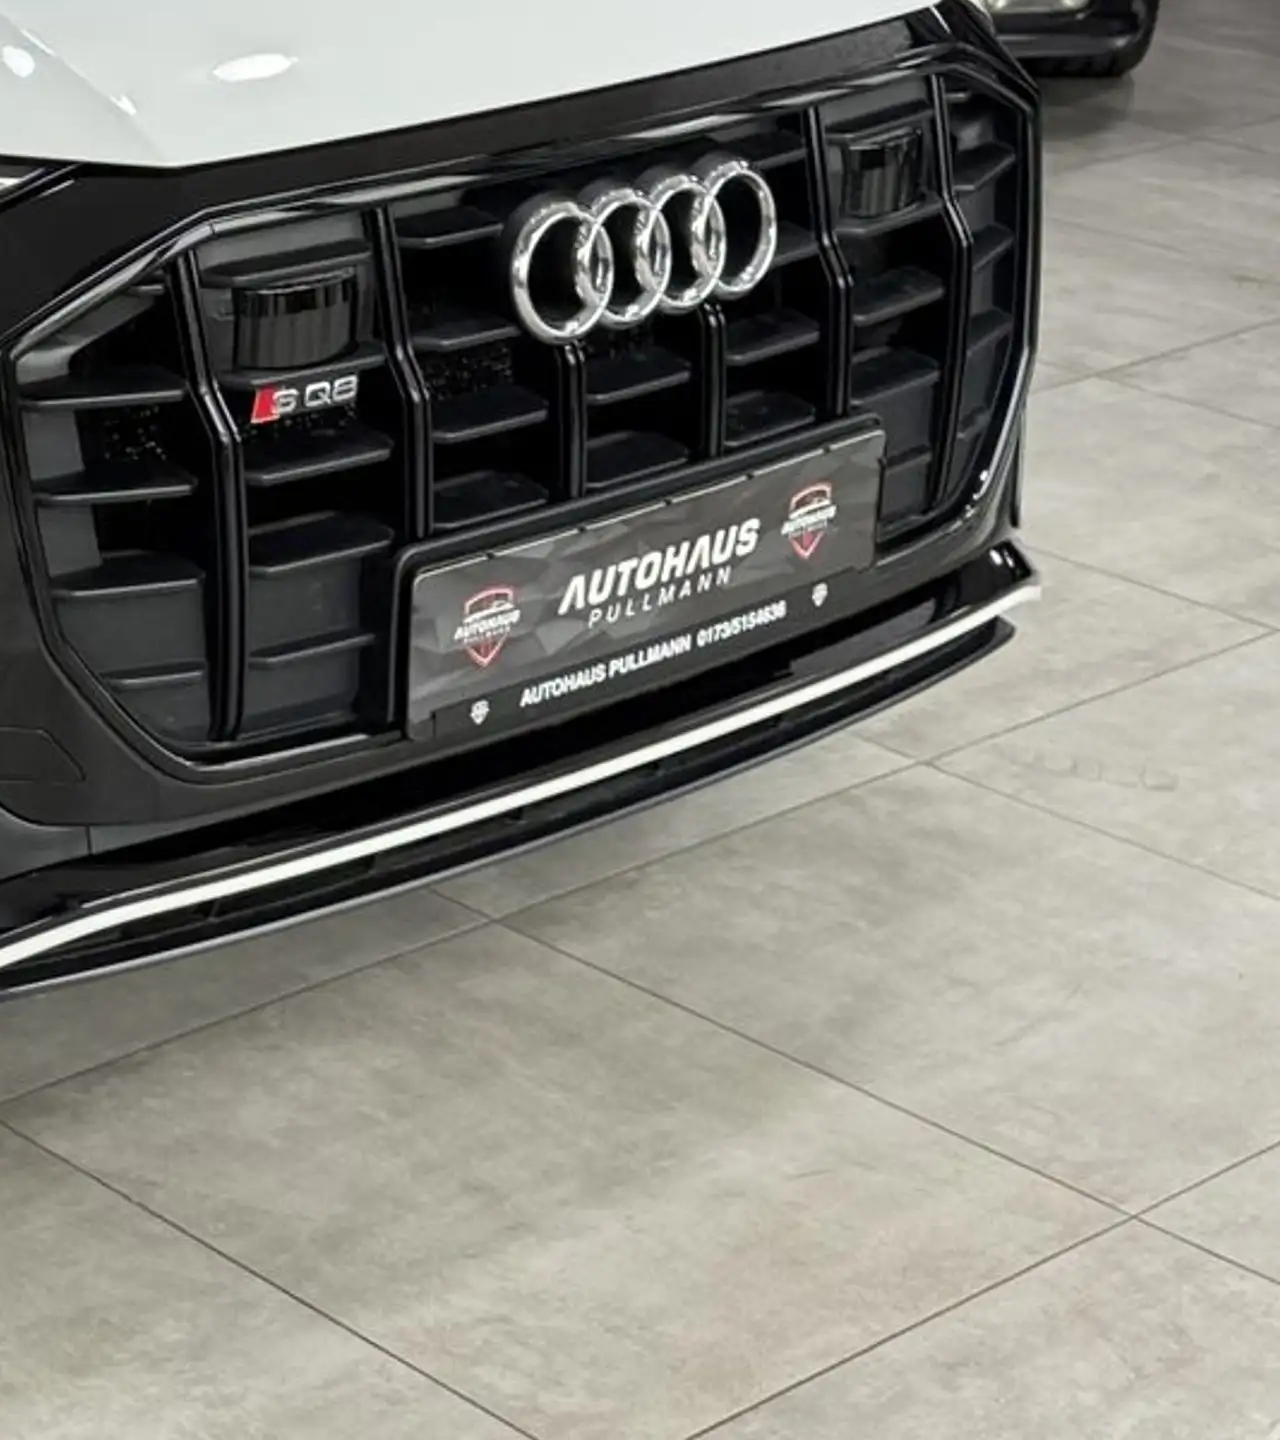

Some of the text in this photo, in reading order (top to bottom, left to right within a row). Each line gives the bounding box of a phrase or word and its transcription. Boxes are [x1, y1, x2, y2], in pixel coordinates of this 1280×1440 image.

[557, 517, 761, 616] AUTOHAUS
[588, 564, 732, 628] PULLMANN
[519, 663, 608, 708] AUTOHAUS
[608, 632, 692, 678] PULLMANN
